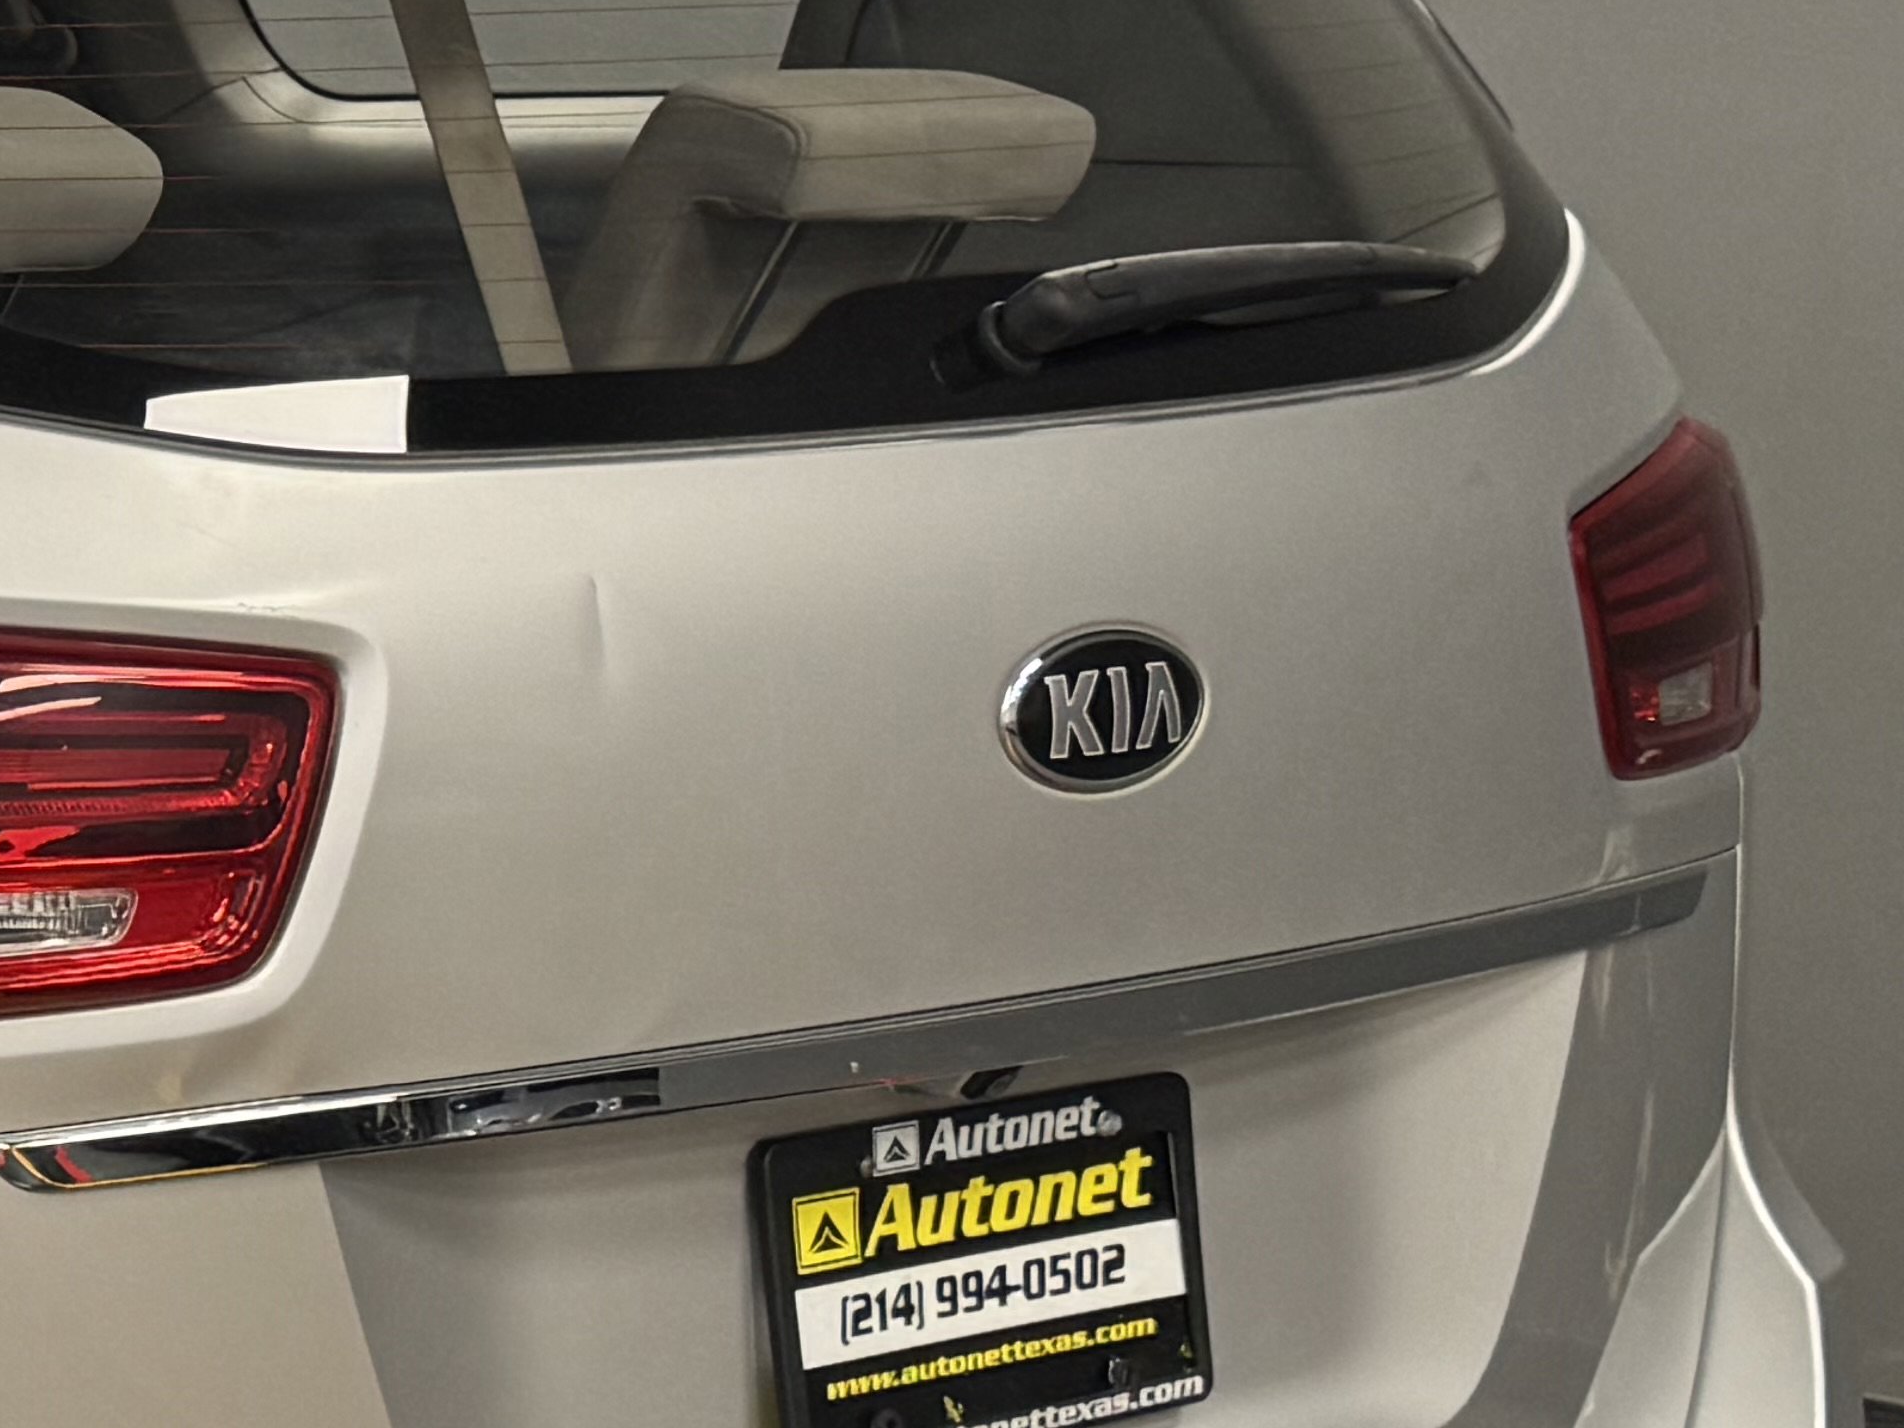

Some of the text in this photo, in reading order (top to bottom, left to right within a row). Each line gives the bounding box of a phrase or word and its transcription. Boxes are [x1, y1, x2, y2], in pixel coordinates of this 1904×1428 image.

[1044, 661, 1182, 760] KIA
[923, 1095, 1101, 1167] Autonet
[864, 1146, 1154, 1258] Autonet
[840, 1242, 1128, 1346] (214) 994-0502
[826, 1316, 1159, 1401] www.autonettexas.com
